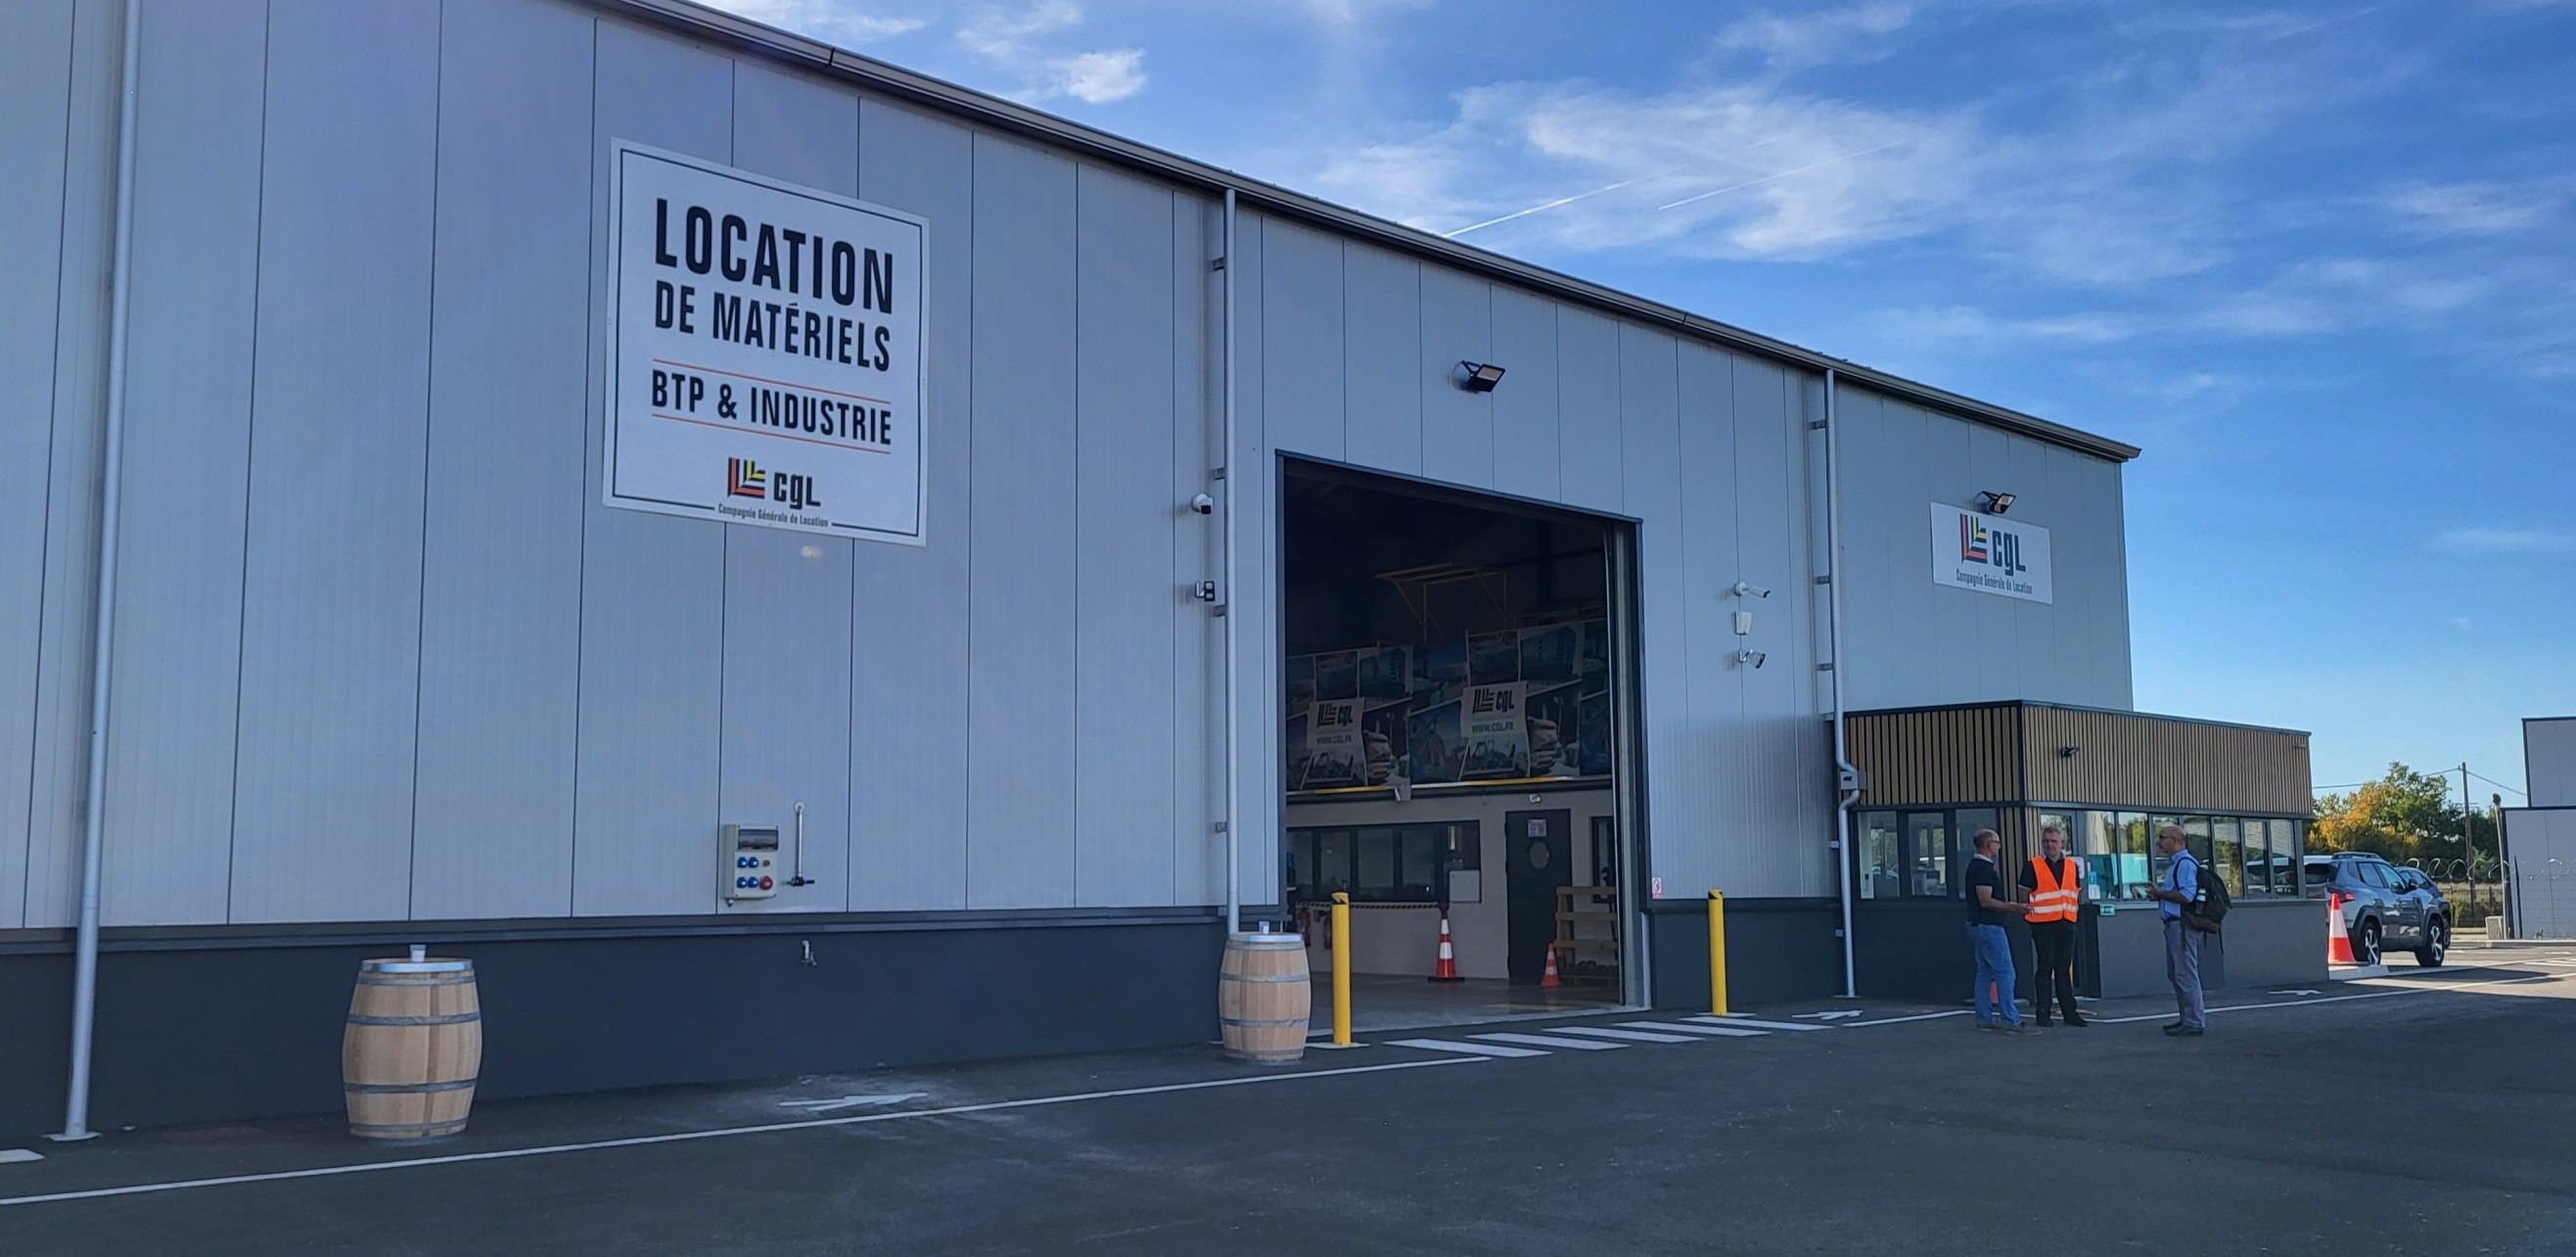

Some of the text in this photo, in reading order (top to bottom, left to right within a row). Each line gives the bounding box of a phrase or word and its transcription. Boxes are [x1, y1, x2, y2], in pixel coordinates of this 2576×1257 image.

[655, 198, 893, 314] LOCATION
[655, 280, 891, 372] DE MATÉRIELS
[652, 369, 892, 445] BTP & INDUSTRIE
[718, 502, 829, 528] Compagnie Générale de Location
